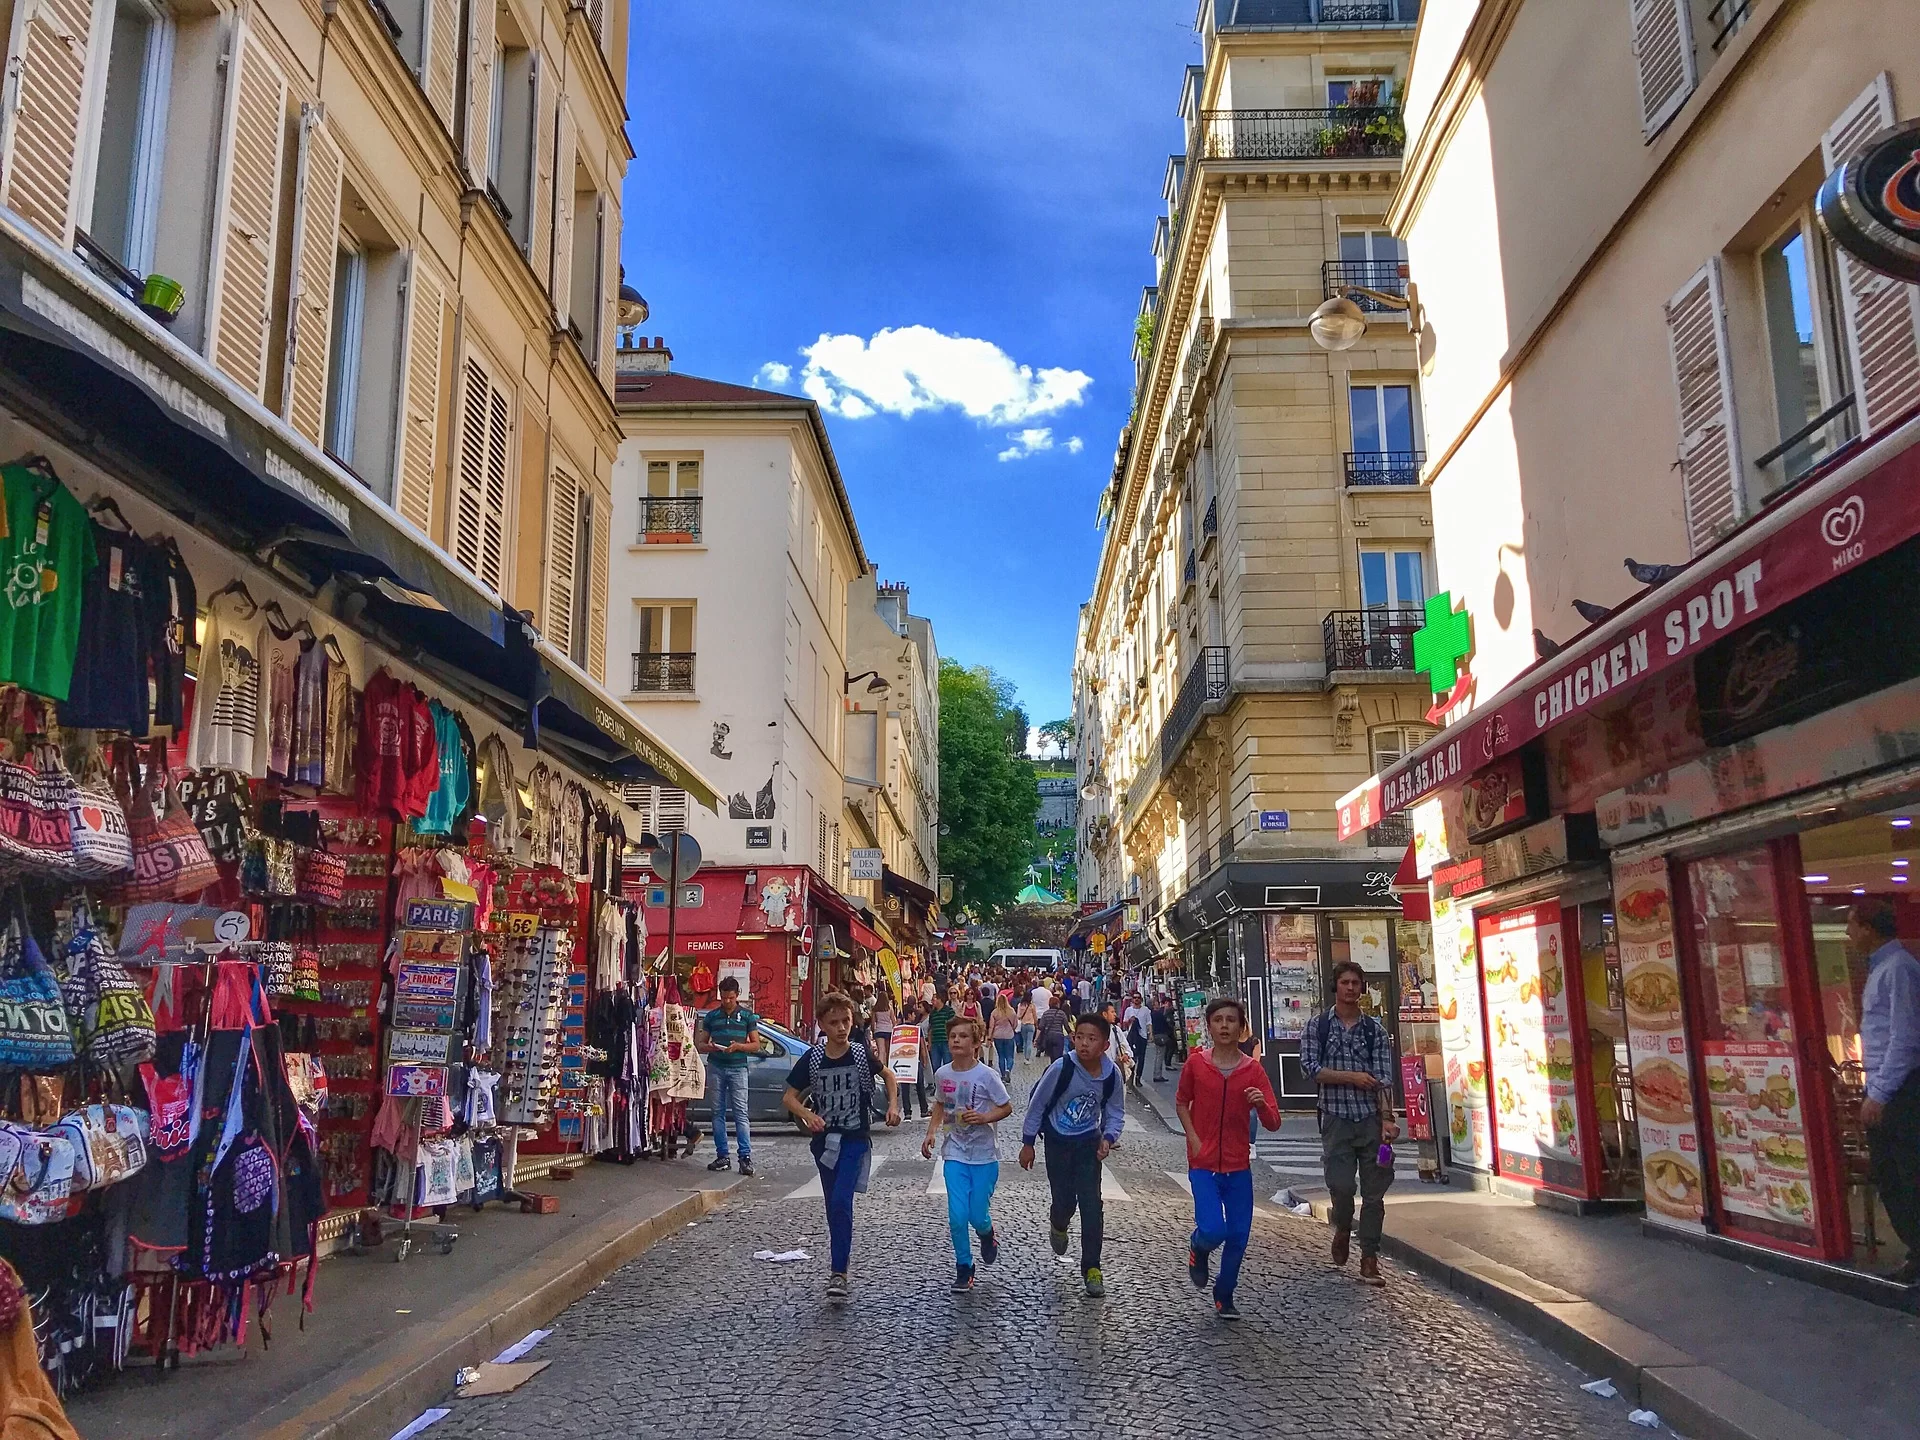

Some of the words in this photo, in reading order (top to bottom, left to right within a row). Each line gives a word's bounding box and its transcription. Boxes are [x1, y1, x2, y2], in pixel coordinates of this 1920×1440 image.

[1832, 541, 1864, 571] MIKO
[1533, 629, 1648, 729] CHICKEN
[1665, 558, 1762, 656] SPOT
[594, 706, 626, 741] GOBELINS
[1383, 740, 1461, 812] 09.53.35.16.01
[852, 850, 881, 859] GALERIES
[859, 859, 874, 868] DES
[853, 869, 881, 878] TISSUS
[412, 907, 460, 924] PARIS
[512, 918, 533, 934] 5€
[687, 941, 724, 951] FEMMES
[412, 973, 443, 985] FRANCE
[406, 1032, 438, 1042] PARIS
[819, 1072, 852, 1092] THE
[813, 1092, 857, 1111] WILD
